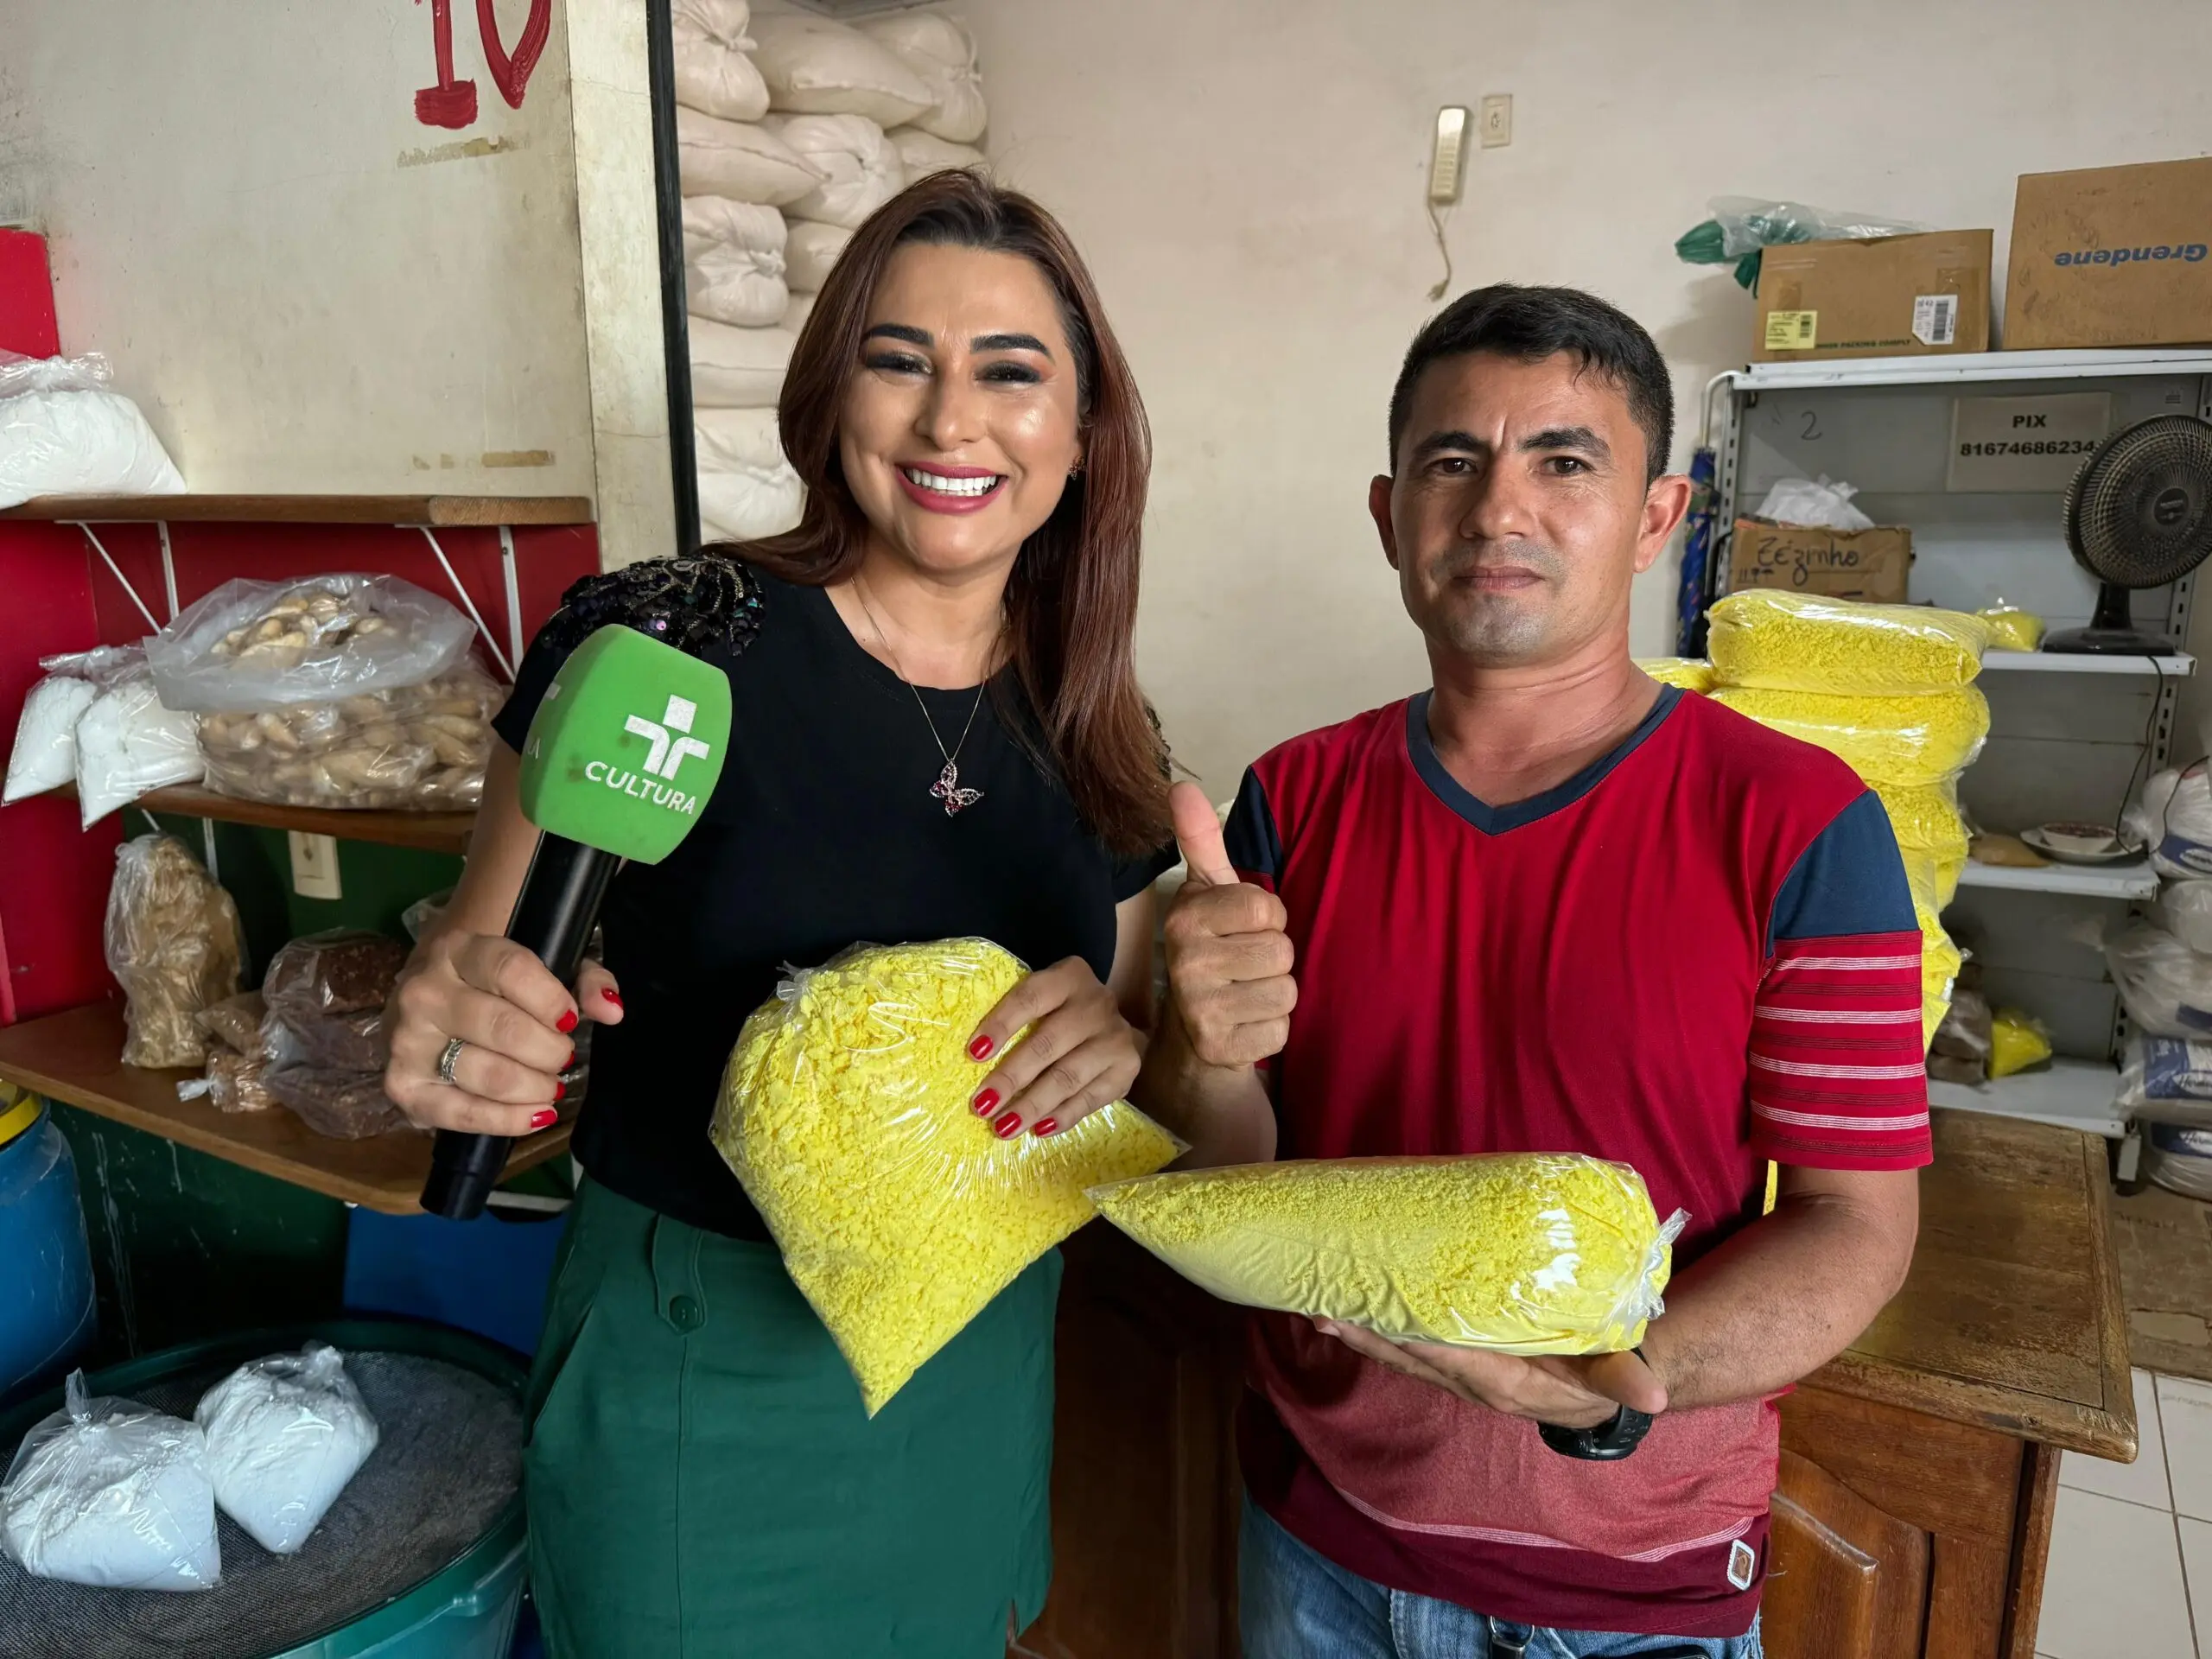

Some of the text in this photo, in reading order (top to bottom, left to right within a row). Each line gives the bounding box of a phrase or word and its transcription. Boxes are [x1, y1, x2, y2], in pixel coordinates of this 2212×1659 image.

[2054, 244, 2208, 266] Grendene
[1801, 410, 1822, 441] 2
[2012, 415, 2047, 429] PIX
[1960, 440, 2095, 456] 81674686234
[585, 760, 696, 815] CULTURA
